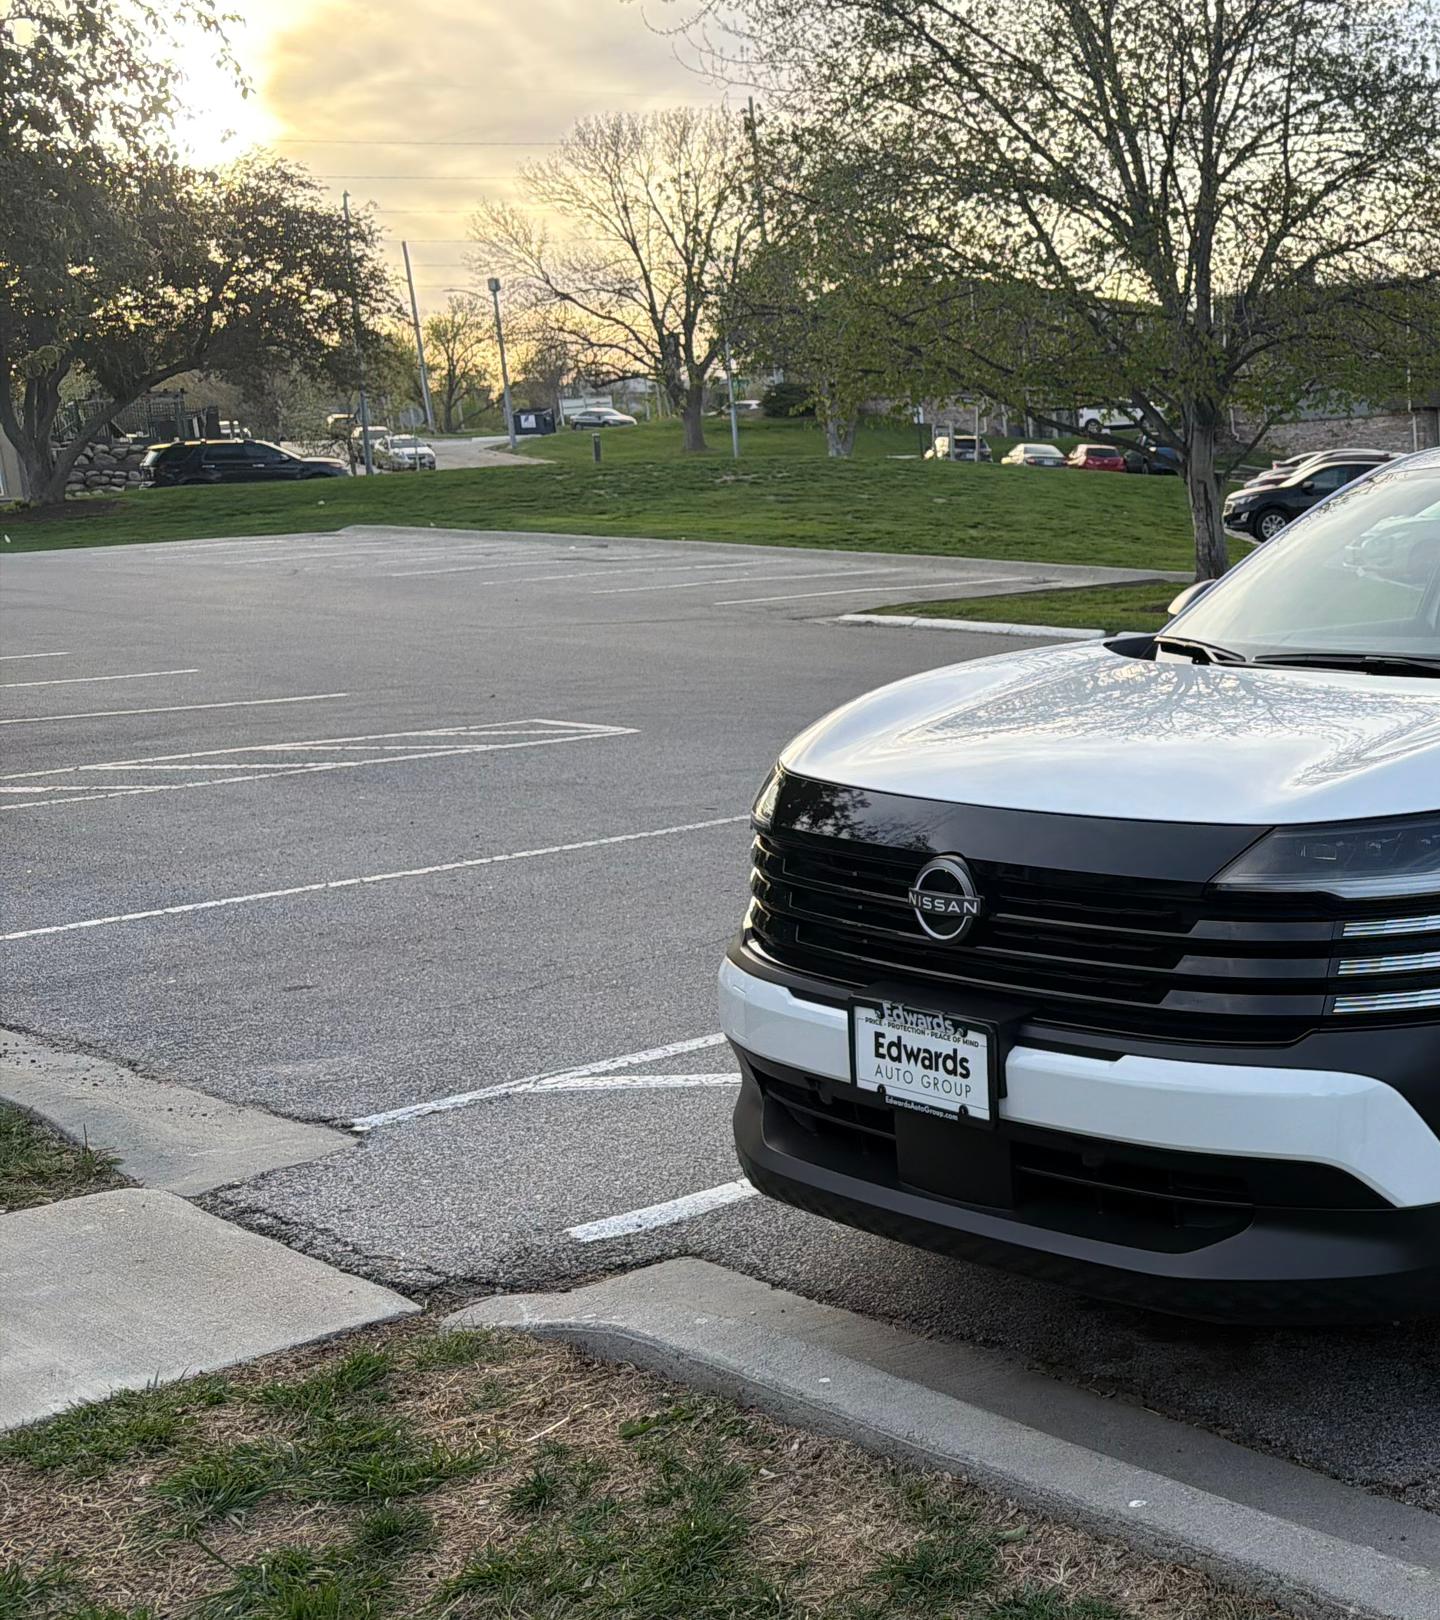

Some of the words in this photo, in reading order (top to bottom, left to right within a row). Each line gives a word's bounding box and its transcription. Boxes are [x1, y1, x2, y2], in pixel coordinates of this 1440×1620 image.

[908, 891, 977, 914] NISSAN
[865, 1017, 882, 1026] PRICE
[888, 1022, 925, 1036] PROTECTION
[953, 1036, 961, 1044] OF
[963, 1038, 979, 1048] MIND
[882, 1000, 955, 1036] Edwards
[874, 1031, 970, 1079] Edwards
[875, 1064, 913, 1084] AUTO
[921, 1074, 972, 1098] GROUP
[885, 1096, 958, 1120] EdwardsAutoGroup.com
